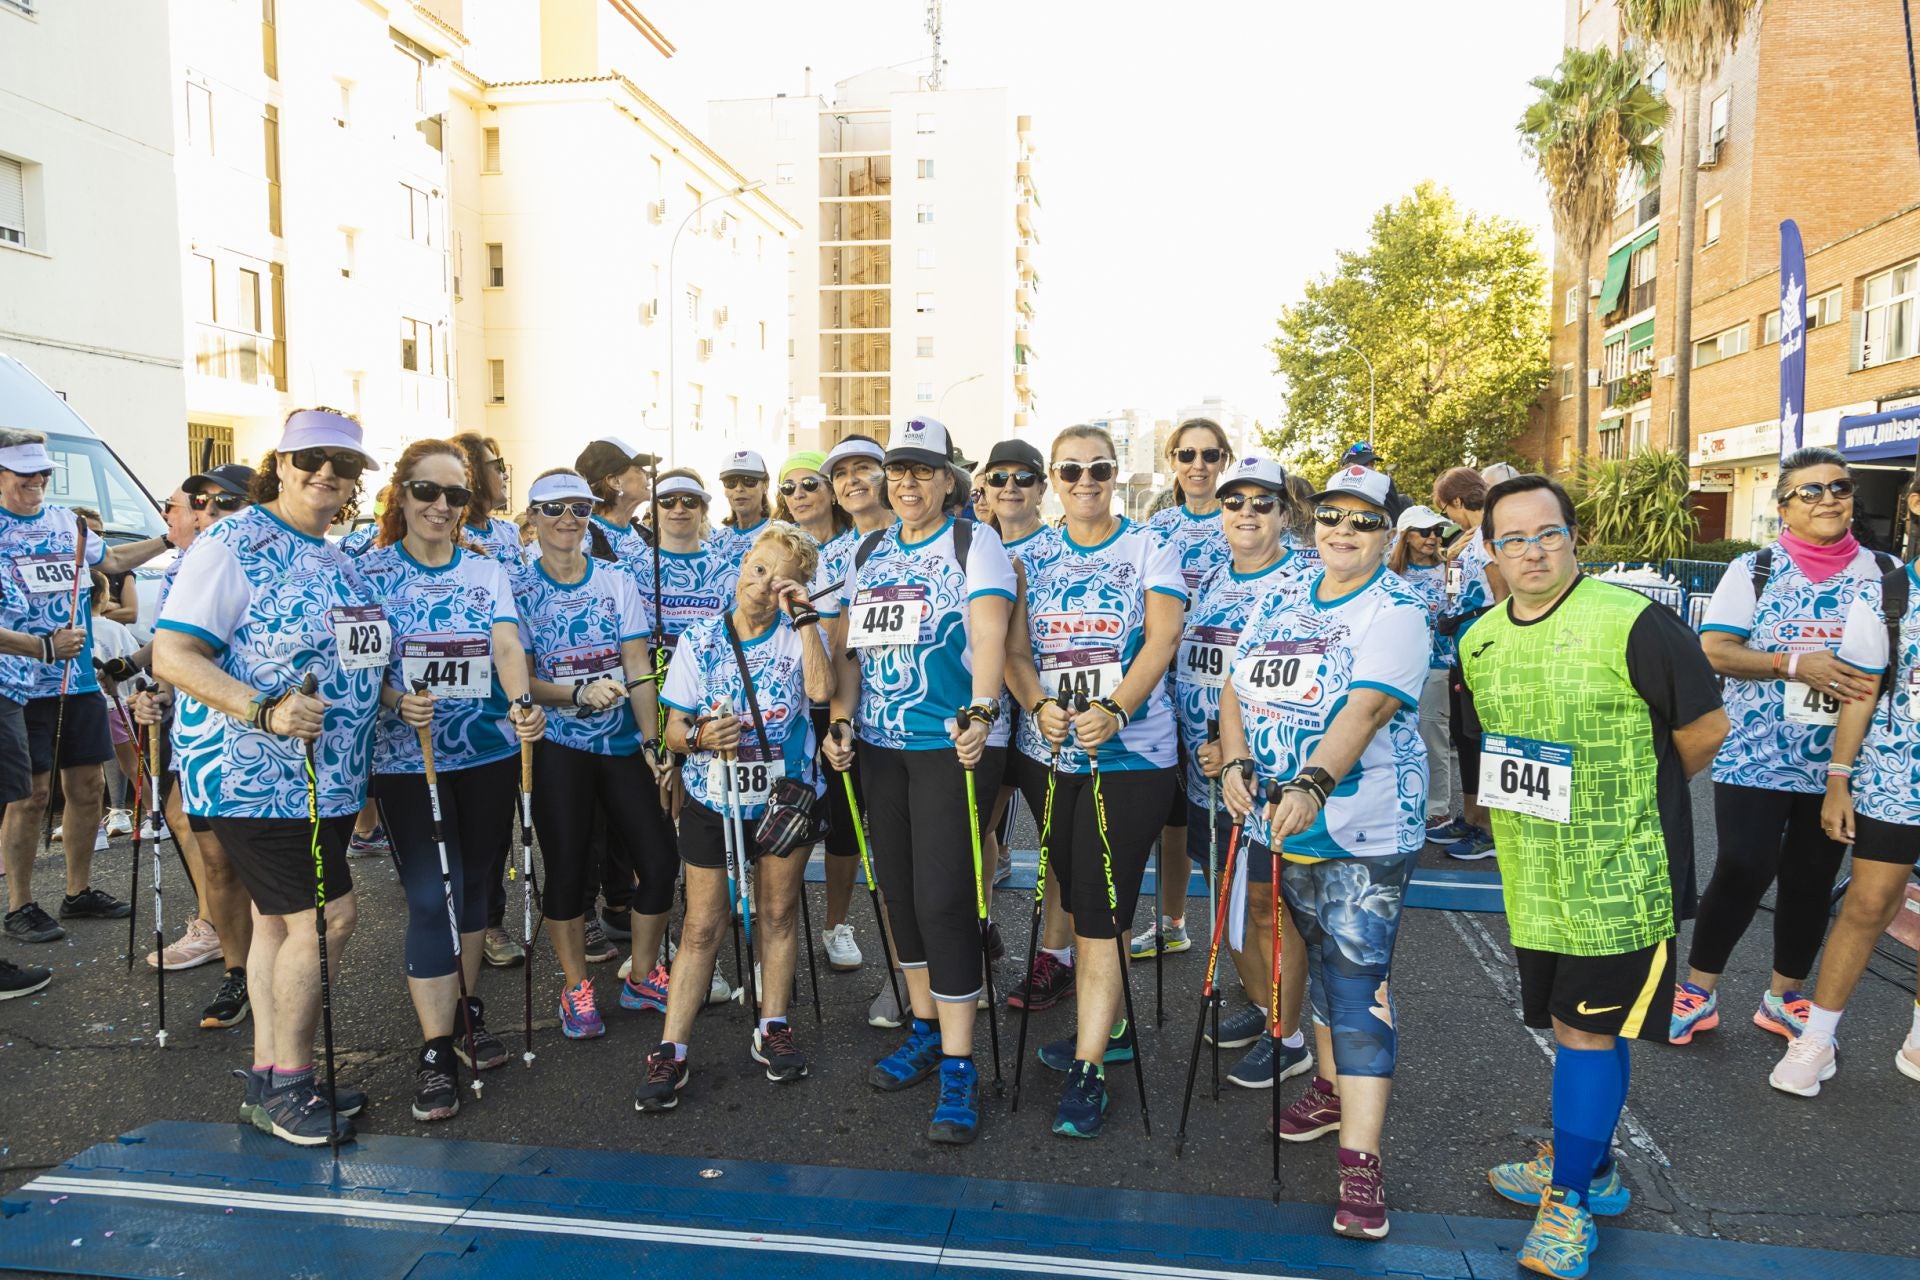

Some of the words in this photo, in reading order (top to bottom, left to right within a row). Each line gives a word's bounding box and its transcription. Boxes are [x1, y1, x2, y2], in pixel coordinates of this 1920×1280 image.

[1845, 418, 1920, 448] www.pulsac
[36, 563, 75, 582] 436
[862, 604, 905, 633] 443
[349, 624, 382, 655] 423
[423, 661, 470, 687] 441
[1187, 645, 1223, 675] 449
[1250, 658, 1301, 688] 430
[1058, 668, 1101, 698] 447
[1803, 687, 1840, 714] 49
[1500, 758, 1551, 802] 644
[308, 781, 317, 824] VIPOLE
[1036, 846, 1049, 901] VARIO
[1207, 942, 1219, 983] VIPOLE
[1272, 980, 1284, 1024] VIPOLE
